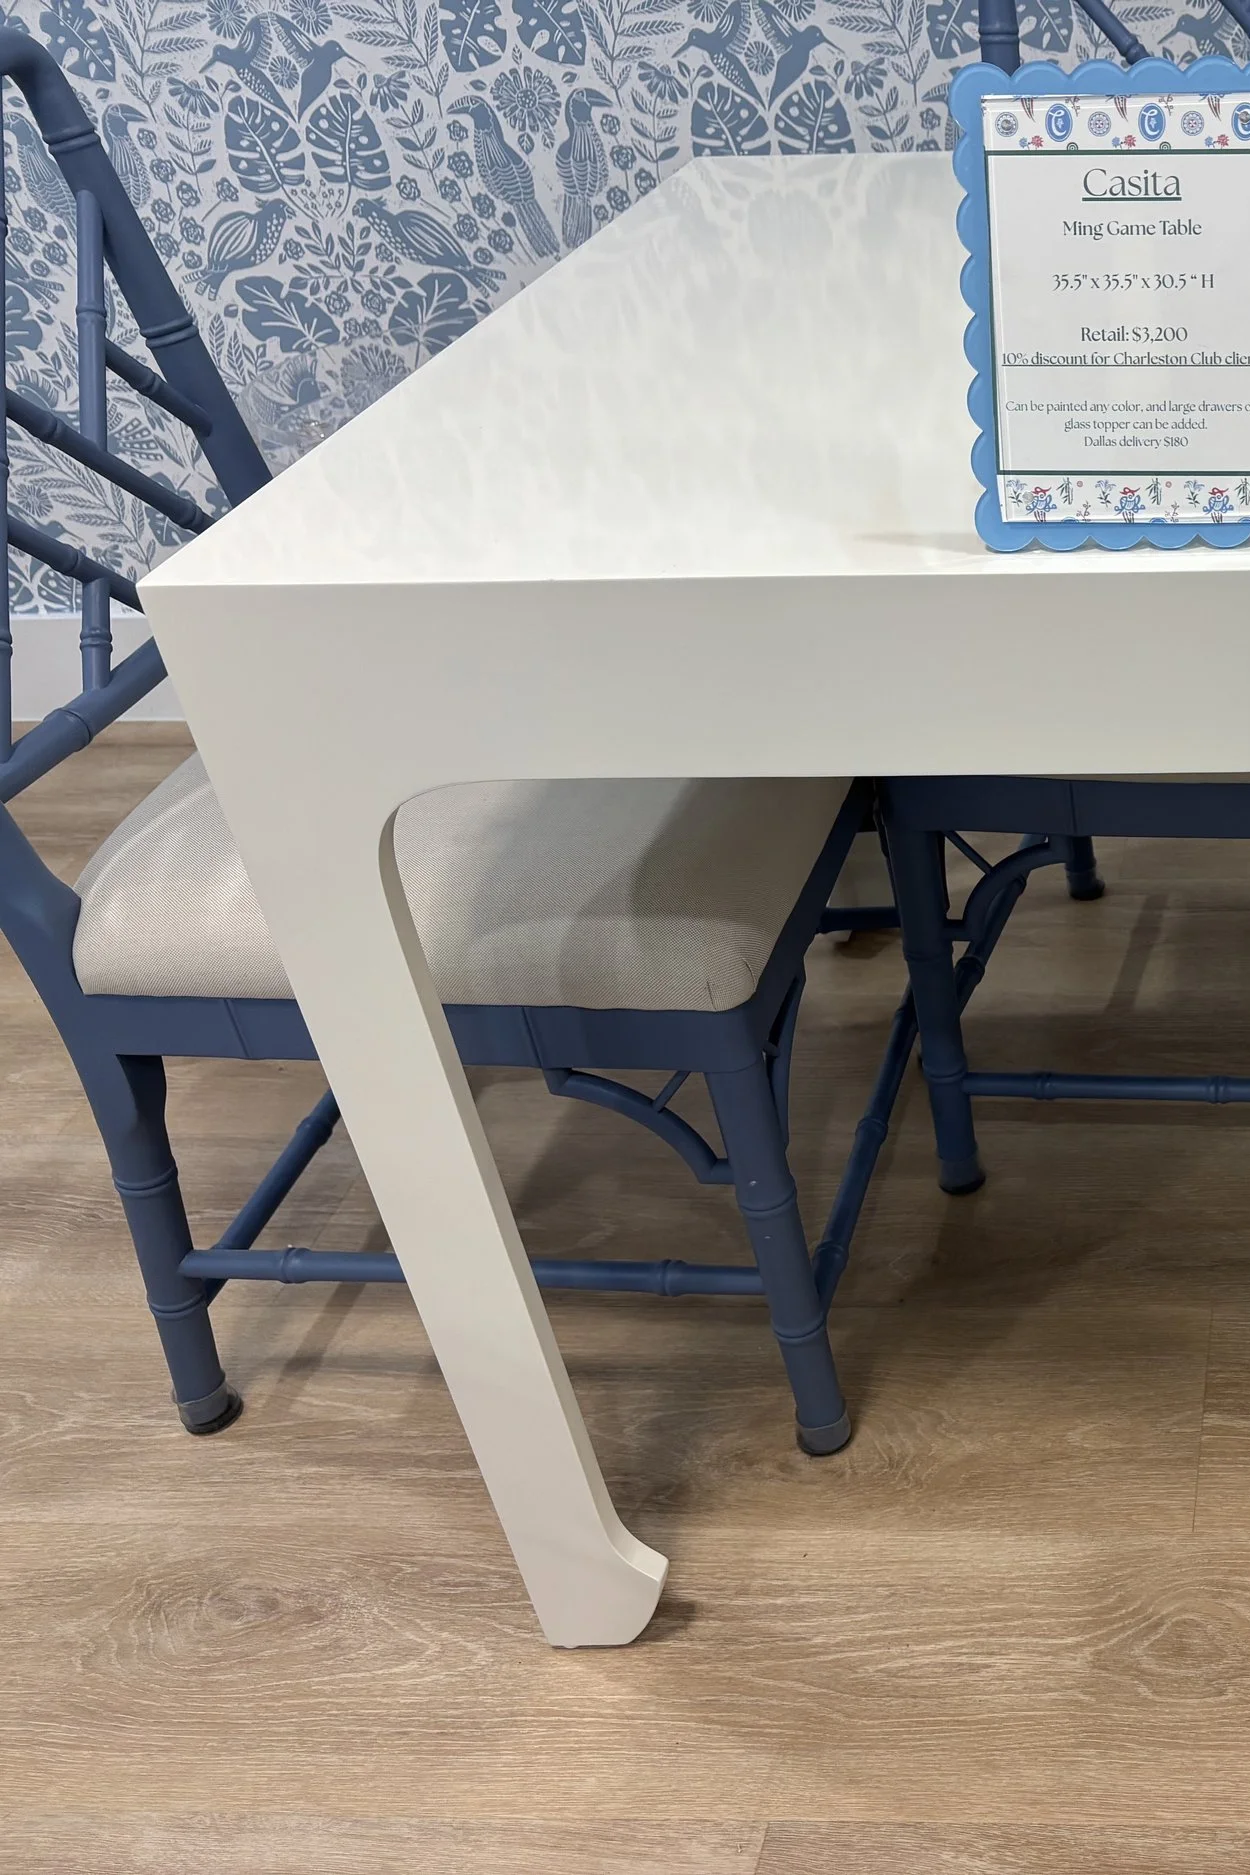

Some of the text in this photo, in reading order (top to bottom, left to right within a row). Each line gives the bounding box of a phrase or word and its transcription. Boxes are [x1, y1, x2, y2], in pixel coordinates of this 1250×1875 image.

[1083, 168, 1182, 198] Casita
[1062, 218, 1203, 241] Ming Game Table
[1052, 273, 1088, 291] 35.5"
[1090, 277, 1100, 289] x
[1103, 273, 1139, 291] 35.5"
[1141, 277, 1151, 289] x
[1201, 273, 1214, 289] H
[1080, 325, 1188, 344] Retail: $3,200
[1002, 352, 1029, 366] 10%
[1030, 351, 1088, 366] discount
[1090, 351, 1111, 366] for
[1113, 351, 1188, 366] Charleston
[1190, 351, 1223, 366] Club
[1005, 400, 1028, 412] Can
[1029, 400, 1045, 412] be
[1046, 400, 1088, 415] painted
[1089, 403, 1110, 414] any
[1111, 400, 1144, 413] color,
[1145, 400, 1167, 412] and
[1168, 400, 1197, 415] large
[1198, 400, 1243, 412] drawers
[1063, 417, 1208, 433] glass topper can be added.
[1084, 435, 1189, 450] Dallas delivery $180
